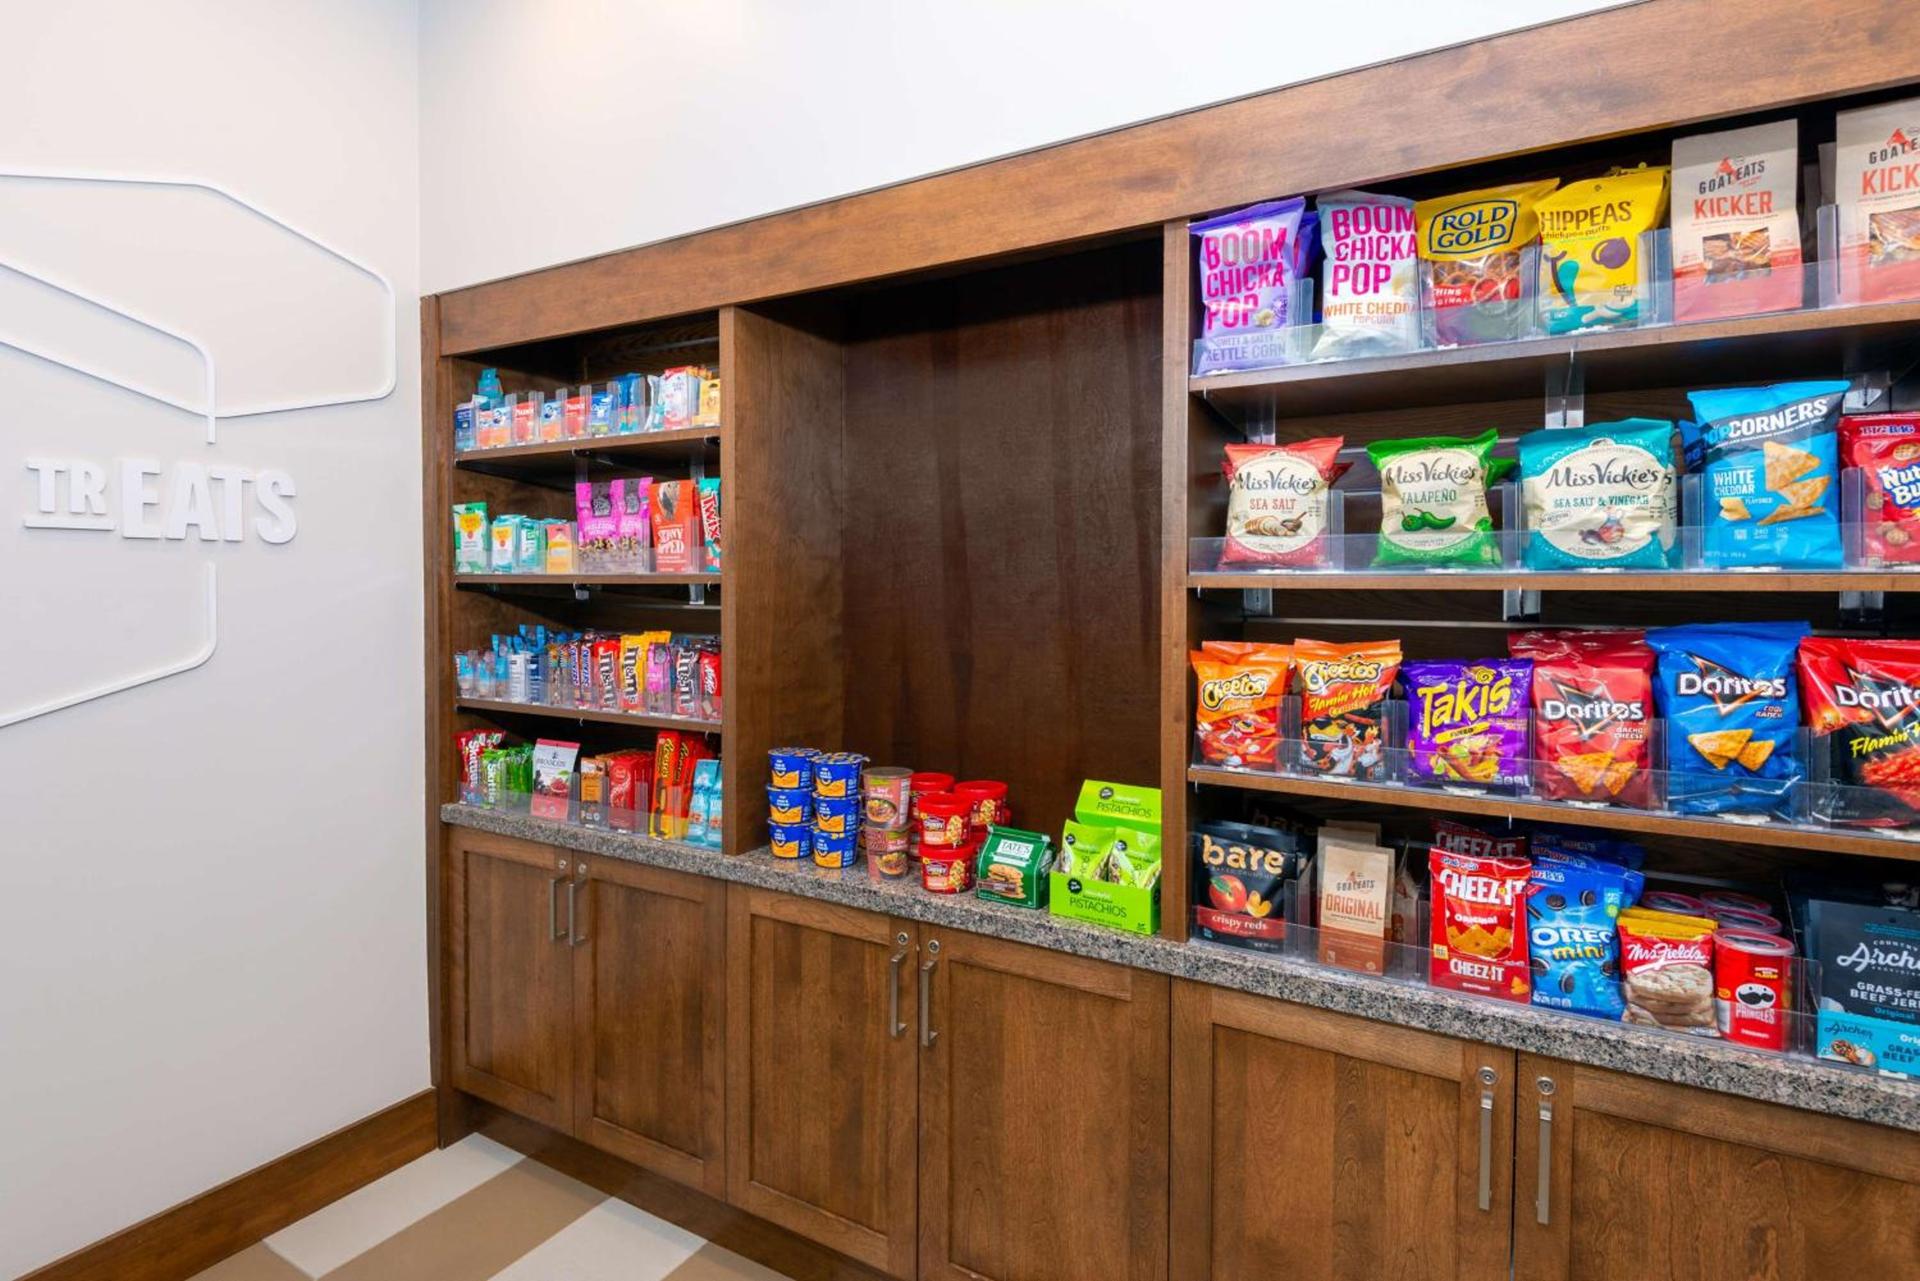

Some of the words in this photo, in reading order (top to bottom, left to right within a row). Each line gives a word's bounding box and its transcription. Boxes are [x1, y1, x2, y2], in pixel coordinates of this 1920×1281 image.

[1698, 173, 1732, 195] GOAT
[1735, 160, 1766, 181] EATS
[1540, 201, 1632, 232] HIPPEAS
[1693, 190, 1774, 219] KICKER
[1331, 205, 1418, 242] BOOM
[1441, 206, 1509, 231] ROLD
[1204, 227, 1288, 272] BOOM
[1334, 234, 1418, 262] CHICKA
[1437, 224, 1506, 249] GOLD
[1206, 261, 1285, 298] CHICKA
[1331, 262, 1391, 296] POP
[1206, 293, 1259, 331] POP
[1325, 302, 1363, 317] WHITE
[1205, 347, 1248, 363] KETTLE
[1251, 343, 1286, 360] CORN
[1231, 470, 1270, 492] Miss
[1266, 466, 1319, 496] Vickie's
[1385, 466, 1424, 487] Miss
[1420, 457, 1477, 486] Vickie's
[1545, 466, 1597, 490] Miss
[1591, 457, 1660, 491] Vickie's
[1713, 468, 1756, 487] WHITE
[1399, 488, 1458, 505] JALAPEÑO
[1553, 498, 1571, 509] SEA
[1572, 497, 1594, 508] SALT
[1608, 495, 1650, 507] VINEGAR
[1713, 484, 1756, 497] CHEDDAR
[1250, 498, 1269, 511] SEA
[1271, 497, 1297, 511] SALT
[1303, 660, 1382, 693] Cheetos
[1679, 673, 1787, 697] Doritos
[1203, 673, 1268, 710] Cheetos
[1544, 700, 1645, 721] Doritos
[1096, 801, 1152, 818] PISTACHIOS
[1202, 834, 1285, 875] bare
[1069, 896, 1128, 919] PISTACHIOS
[1325, 893, 1383, 921] ORIGINAL
[1211, 914, 1241, 929] crispy
[1244, 920, 1269, 931] reds
[1553, 943, 1606, 961] mini
[1837, 941, 1920, 972] Arch
[1850, 987, 1887, 1003] BEEF
[1891, 997, 1920, 1009] JER
[1735, 1002, 1776, 1025] PRINGLES
